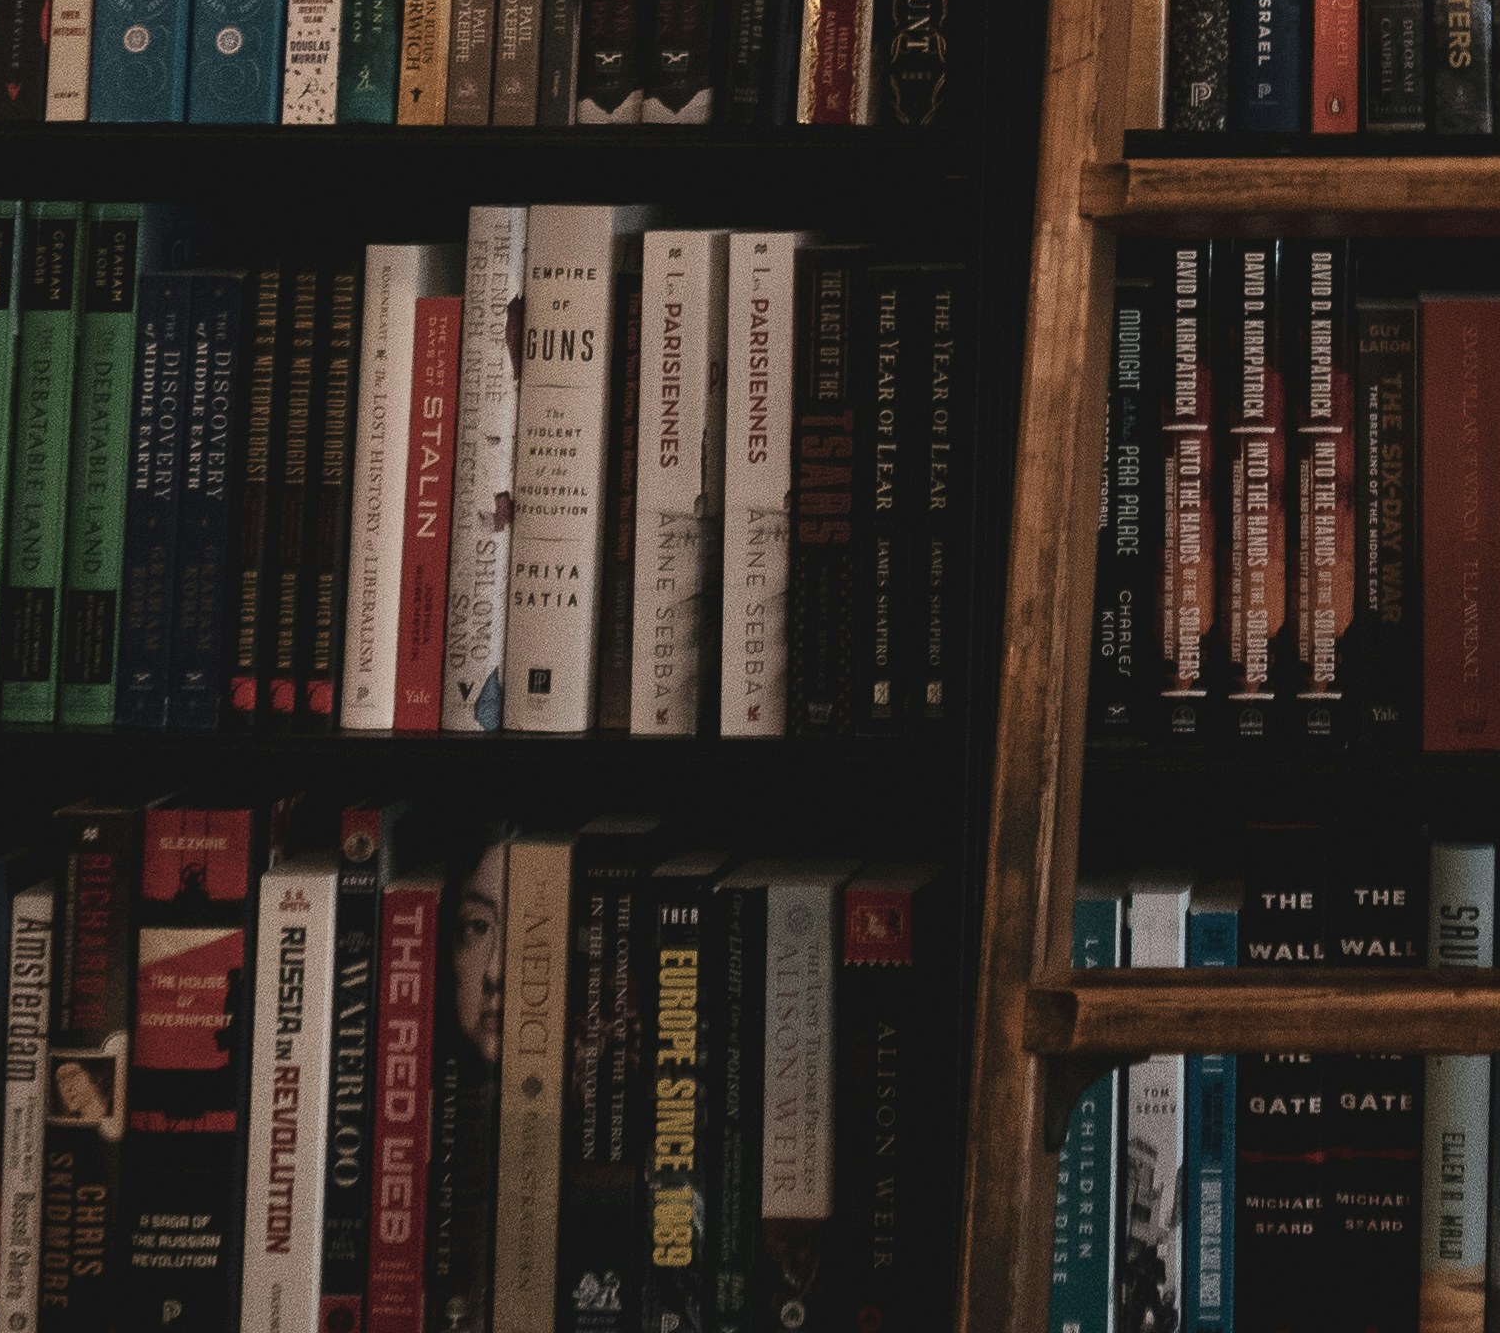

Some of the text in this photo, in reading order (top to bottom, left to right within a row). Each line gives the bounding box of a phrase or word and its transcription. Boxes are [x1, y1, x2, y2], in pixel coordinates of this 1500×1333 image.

[524, 328, 596, 364] GUNS
[416, 394, 443, 540] STALIN
[514, 563, 580, 582] PRIYA
[514, 591, 579, 608] SATIA
[1262, 893, 1313, 910] THE
[1249, 943, 1326, 961] WALL
[265, 926, 307, 1256] RUSSIA IN REVOLUTION
[650, 949, 699, 1270] EUROPE SINCE 1989
[1250, 1095, 1323, 1117] GATE
